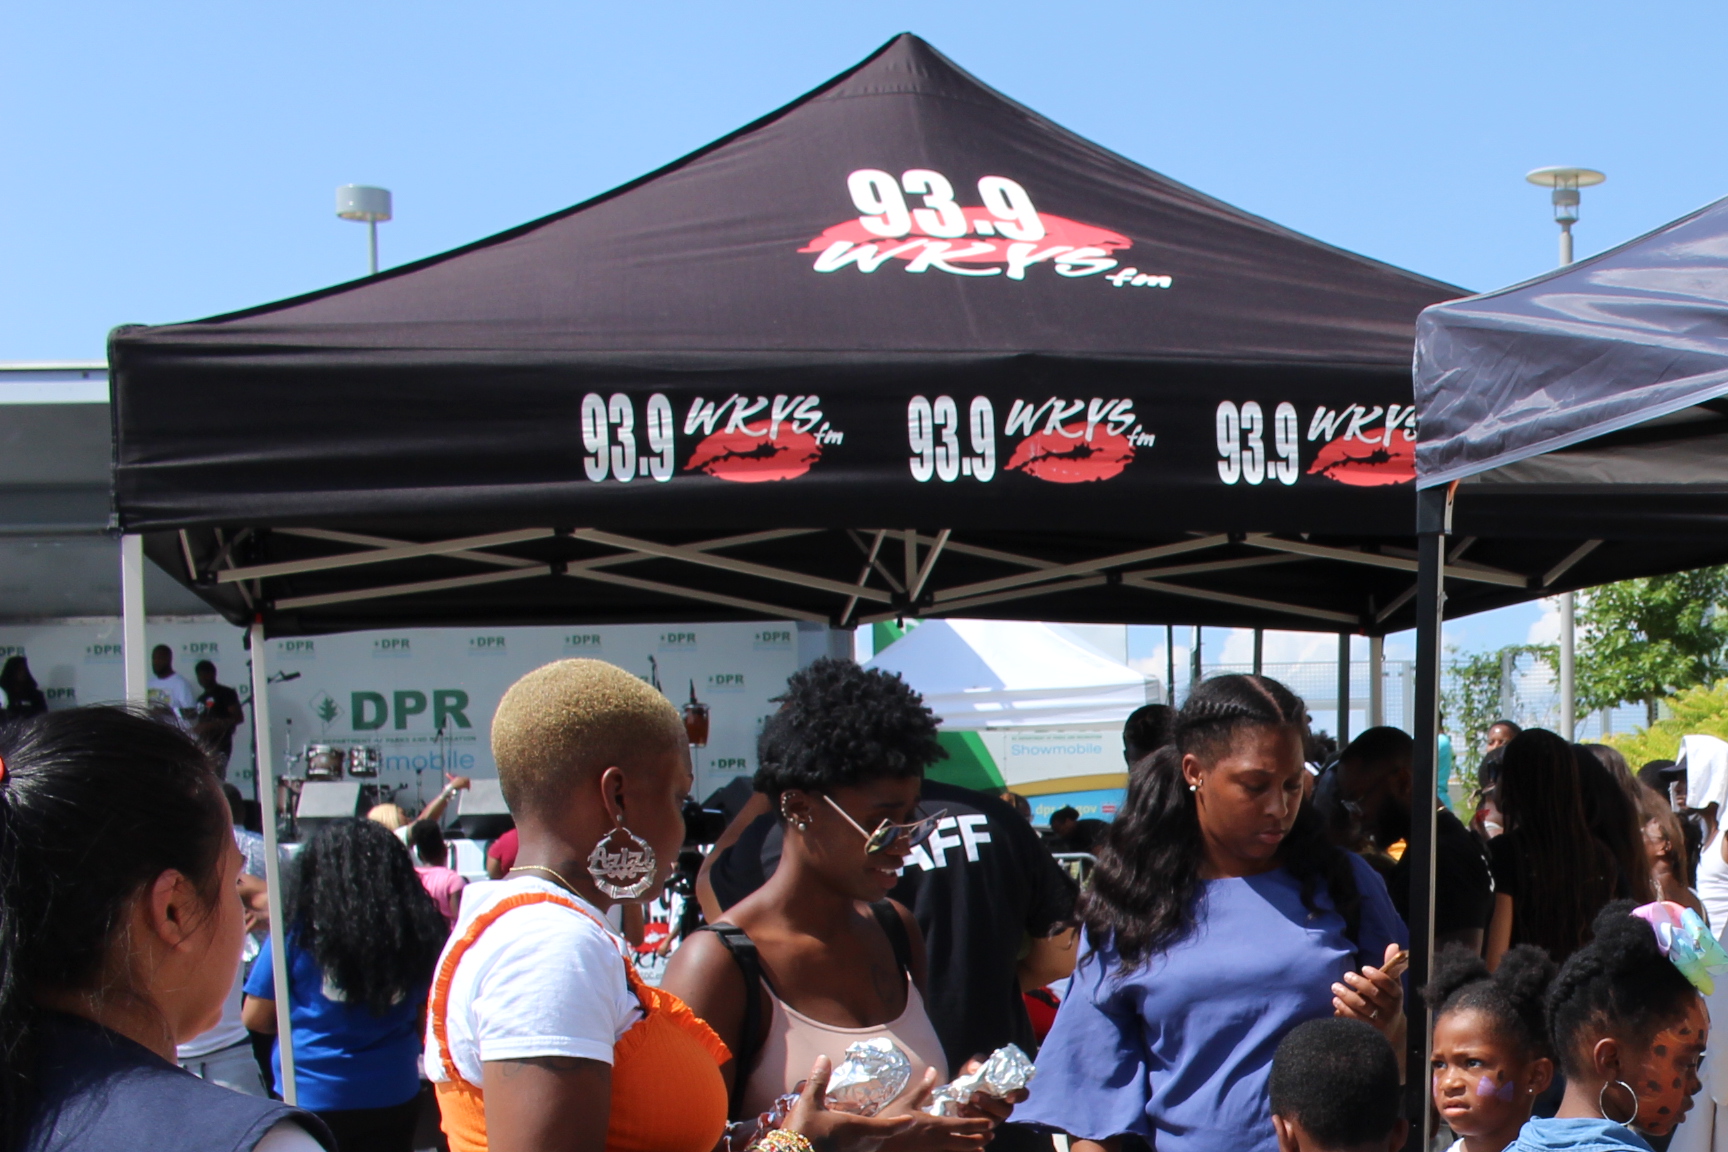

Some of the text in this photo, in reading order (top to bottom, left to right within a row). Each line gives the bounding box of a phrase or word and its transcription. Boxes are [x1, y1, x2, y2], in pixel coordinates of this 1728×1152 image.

[847, 168, 1046, 241] 93.9
[813, 238, 1119, 280] WKYS
[581, 392, 844, 483] 93.9 WKYS fm
[908, 395, 1155, 483] 93.9 WKYS fm
[1215, 400, 1300, 486] 93.9
[477, 636, 506, 647] DPR
[572, 634, 600, 645] DPR
[668, 632, 696, 643] DPR
[763, 631, 791, 642] DPR
[189, 642, 219, 653] DPR
[286, 640, 315, 651] DPR
[382, 638, 410, 649] DPR
[93, 645, 122, 655] DPR
[716, 674, 744, 684] DPR
[47, 687, 76, 698] DPR
[351, 688, 472, 731] DPR
[1011, 743, 1103, 756] Showmobile
[718, 758, 746, 769] DPR
